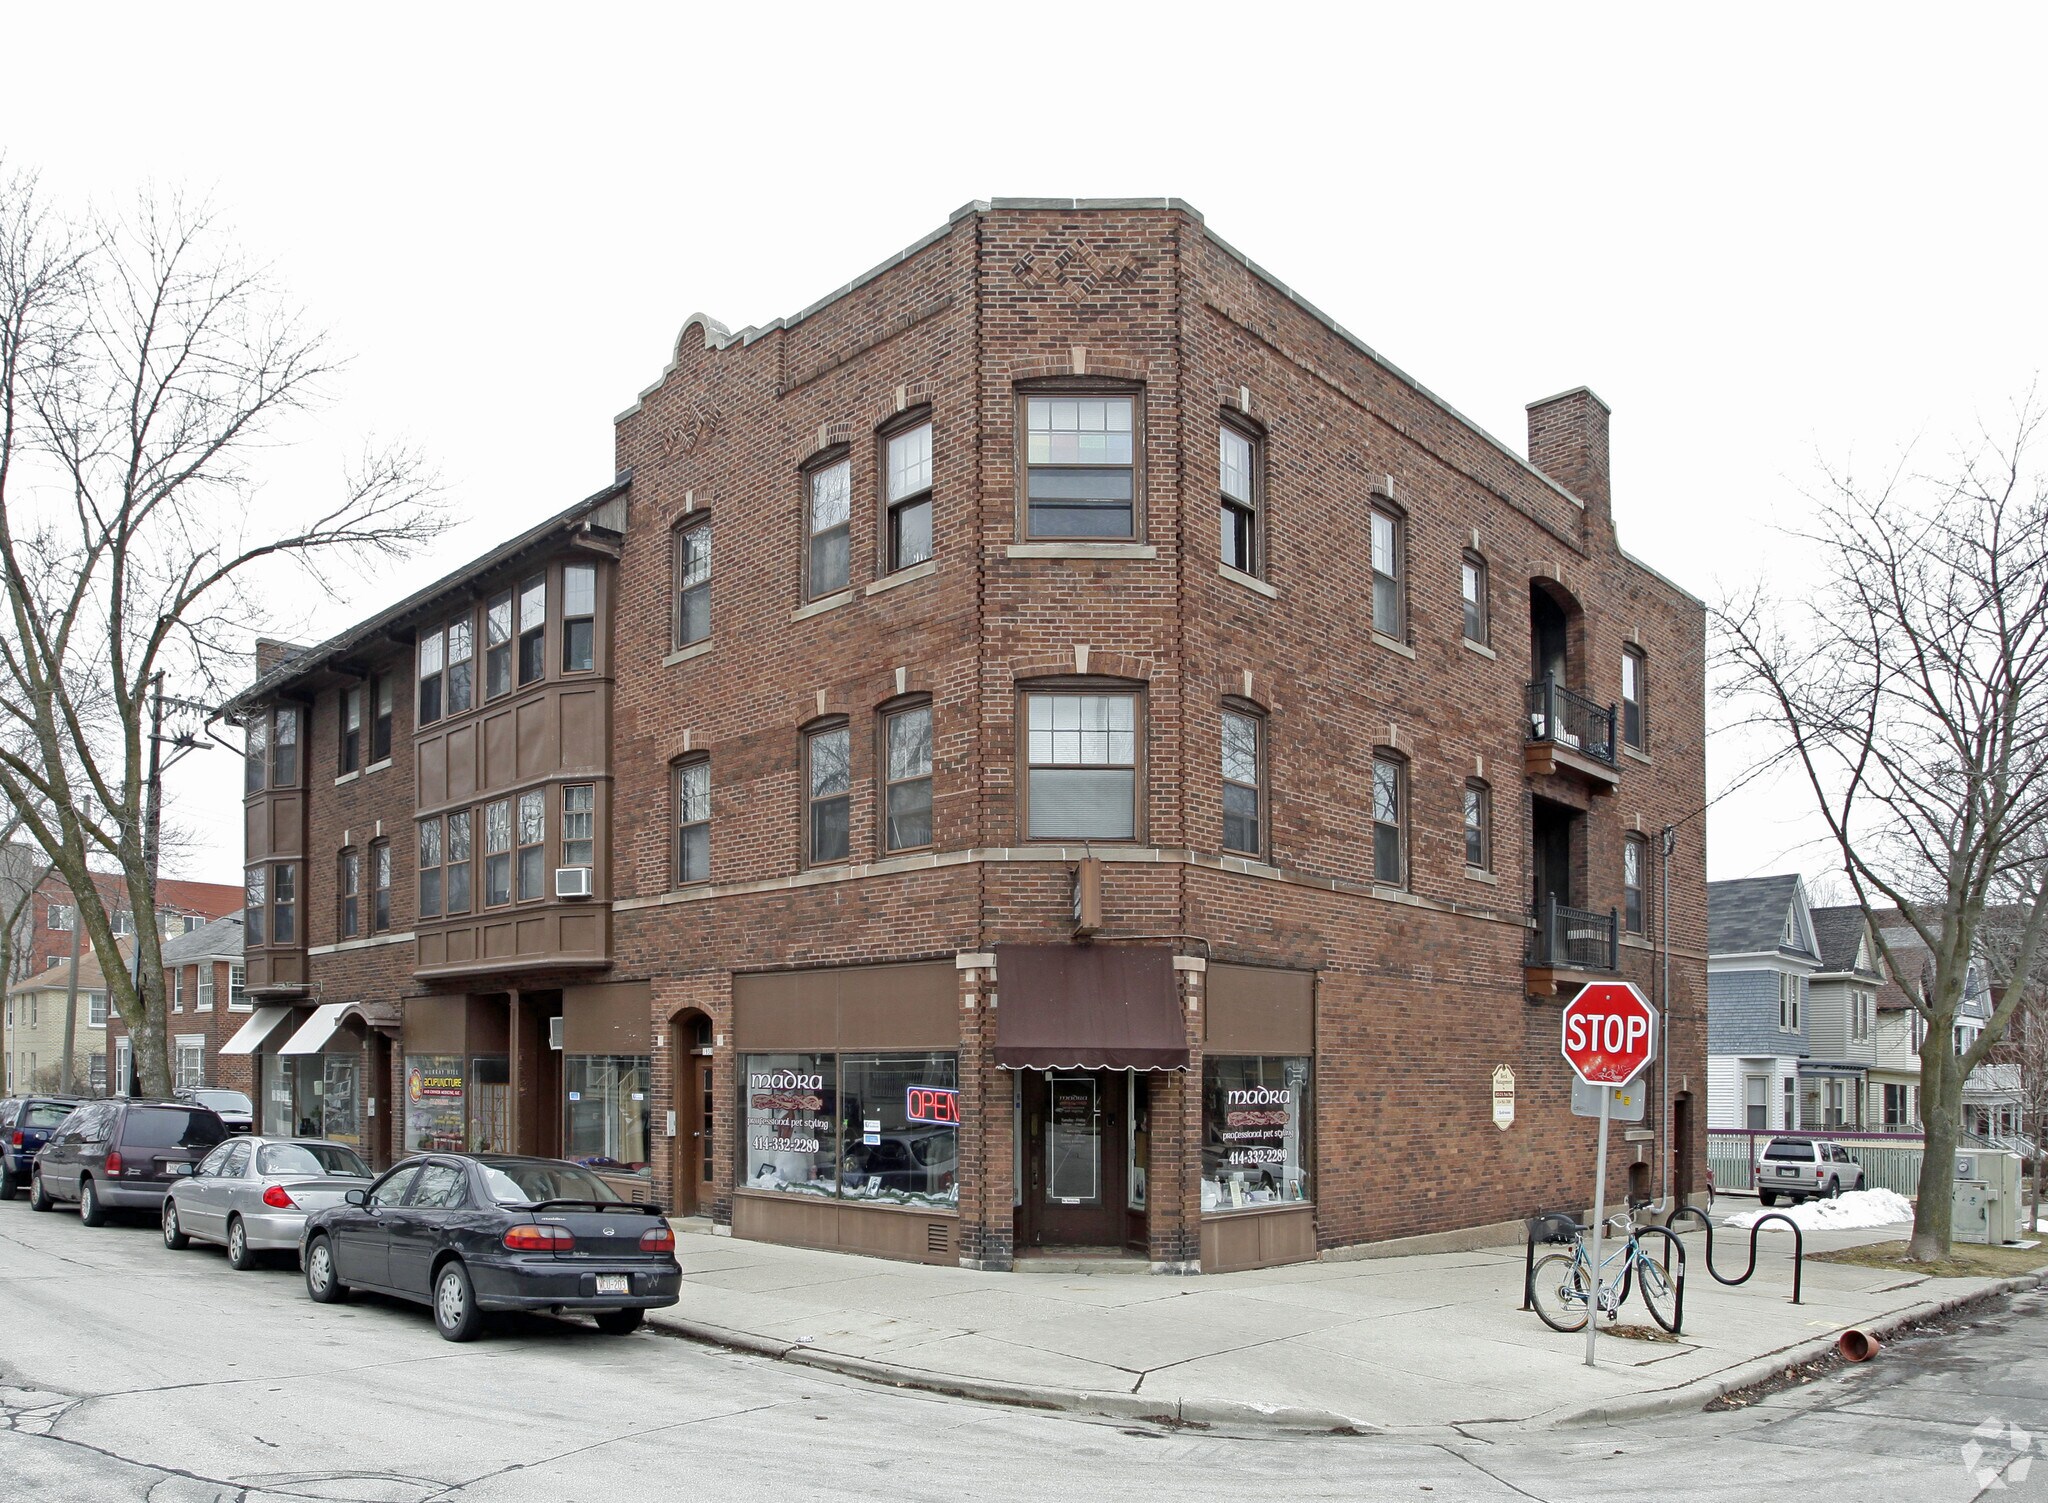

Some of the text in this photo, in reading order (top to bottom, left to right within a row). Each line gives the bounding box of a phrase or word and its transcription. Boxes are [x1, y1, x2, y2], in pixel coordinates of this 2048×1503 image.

[1567, 1013, 1647, 1054] STOP
[909, 1090, 960, 1122] OPEN
[747, 1117, 829, 1130] professional pet styling
[1222, 1129, 1294, 1141] professional pet styling
[752, 1135, 820, 1153] 414-332-2289
[1228, 1148, 1288, 1165] 414-332-2289
